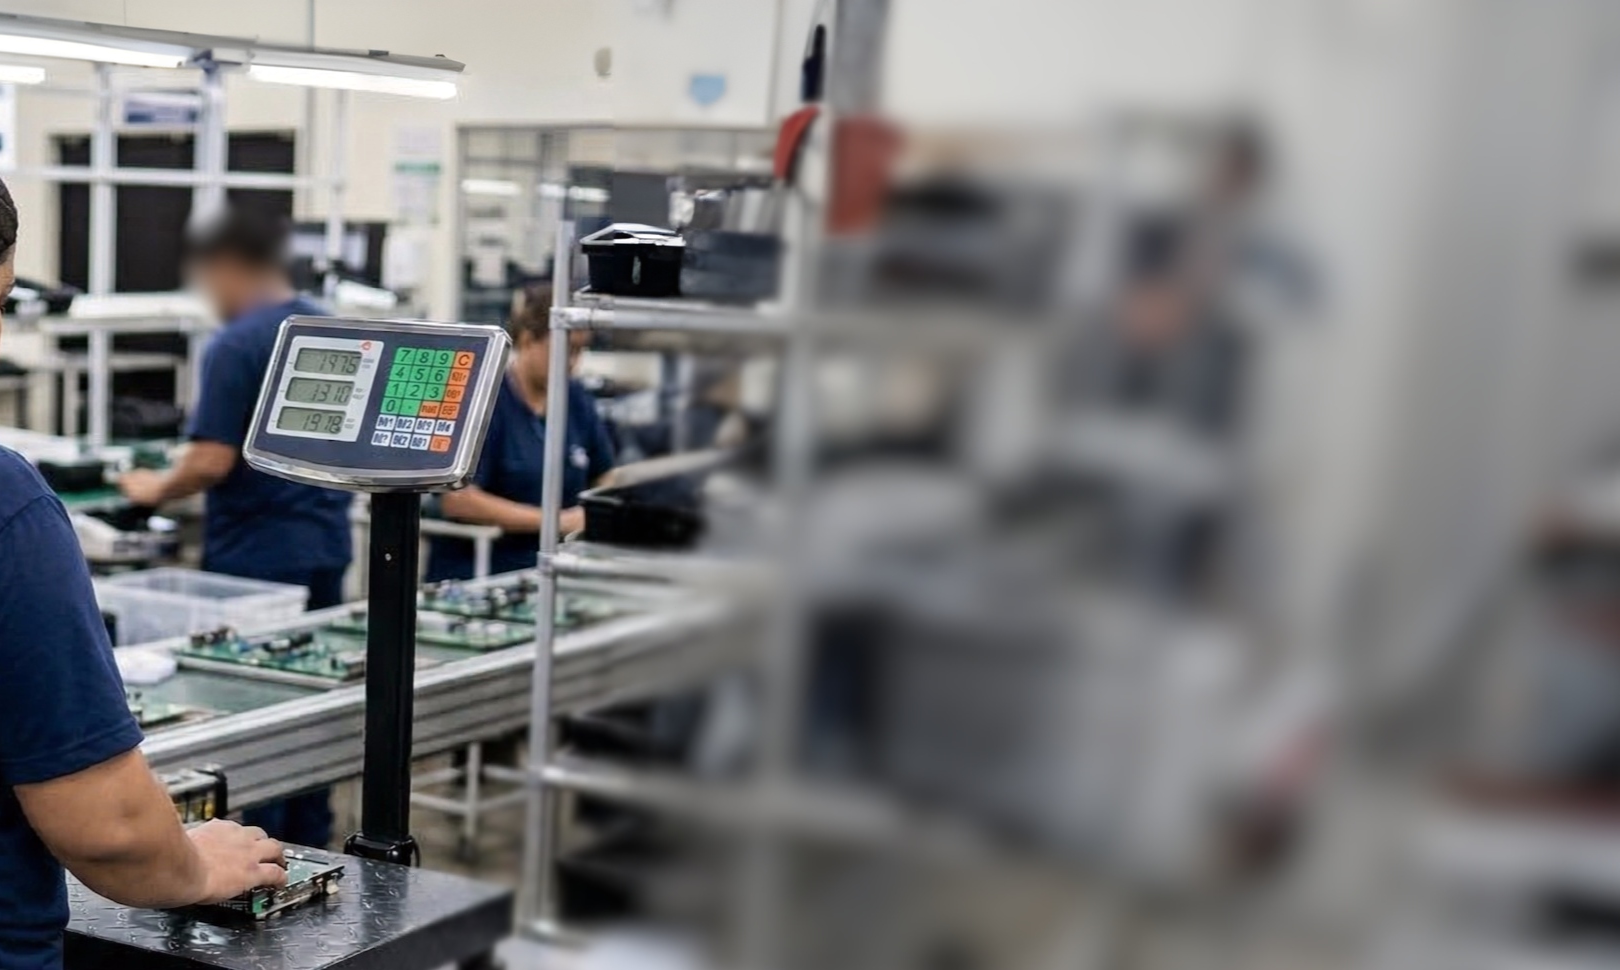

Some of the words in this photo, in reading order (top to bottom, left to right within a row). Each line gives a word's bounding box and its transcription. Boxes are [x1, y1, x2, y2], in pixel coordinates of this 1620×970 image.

[319, 353, 359, 374] 1975
[401, 349, 411, 361] 7
[419, 351, 430, 363] 8
[440, 353, 449, 365] 9
[458, 354, 470, 366] C
[396, 367, 405, 379] 4
[414, 368, 425, 380] 5
[435, 370, 445, 382] 6
[312, 383, 352, 403] 1310
[392, 383, 400, 395] 1
[410, 385, 420, 397] 2
[429, 387, 439, 399] 3
[386, 400, 396, 412] 0
